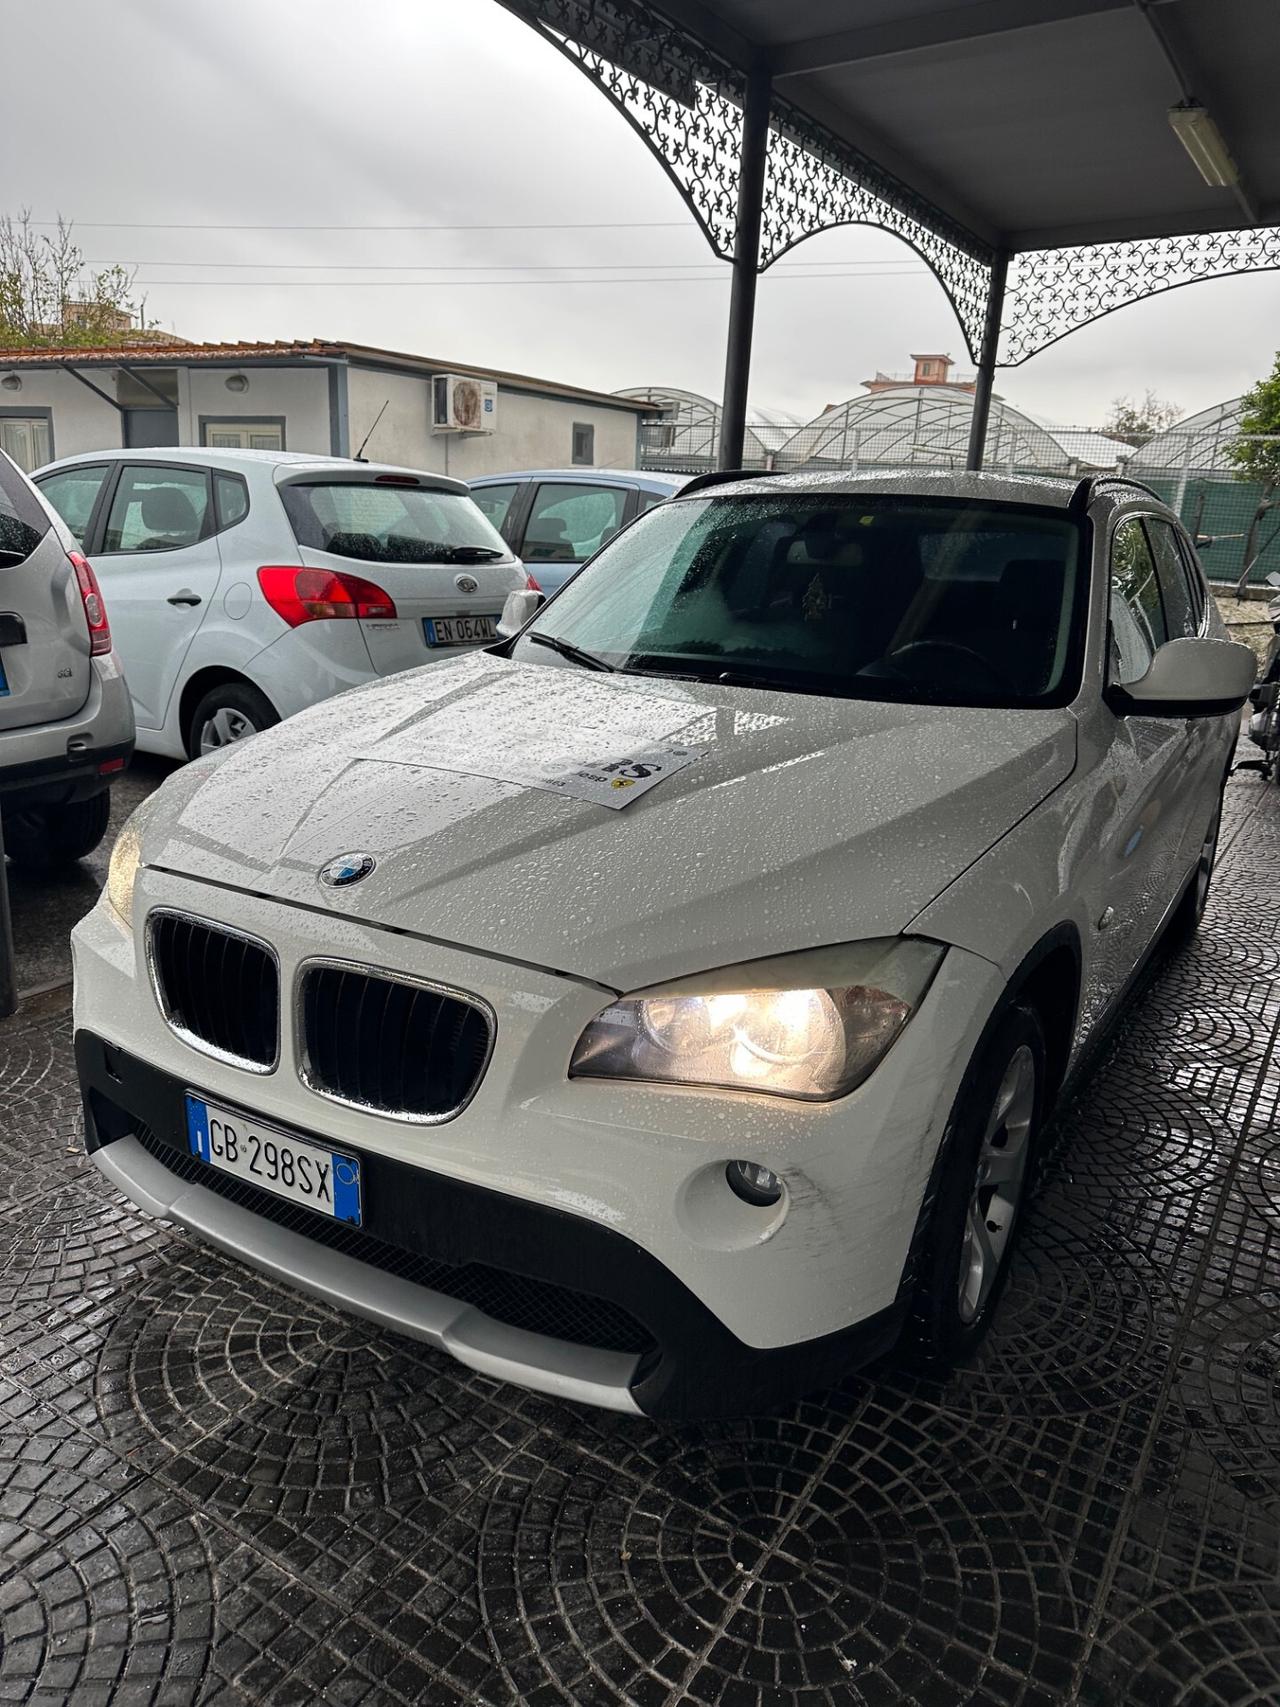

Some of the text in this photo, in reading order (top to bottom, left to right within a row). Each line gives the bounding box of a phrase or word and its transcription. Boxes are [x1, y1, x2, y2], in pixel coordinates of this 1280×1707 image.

[434, 621, 453, 641] EN
[456, 619, 497, 639] 064WL
[210, 1119, 331, 1202] GB 298SX
